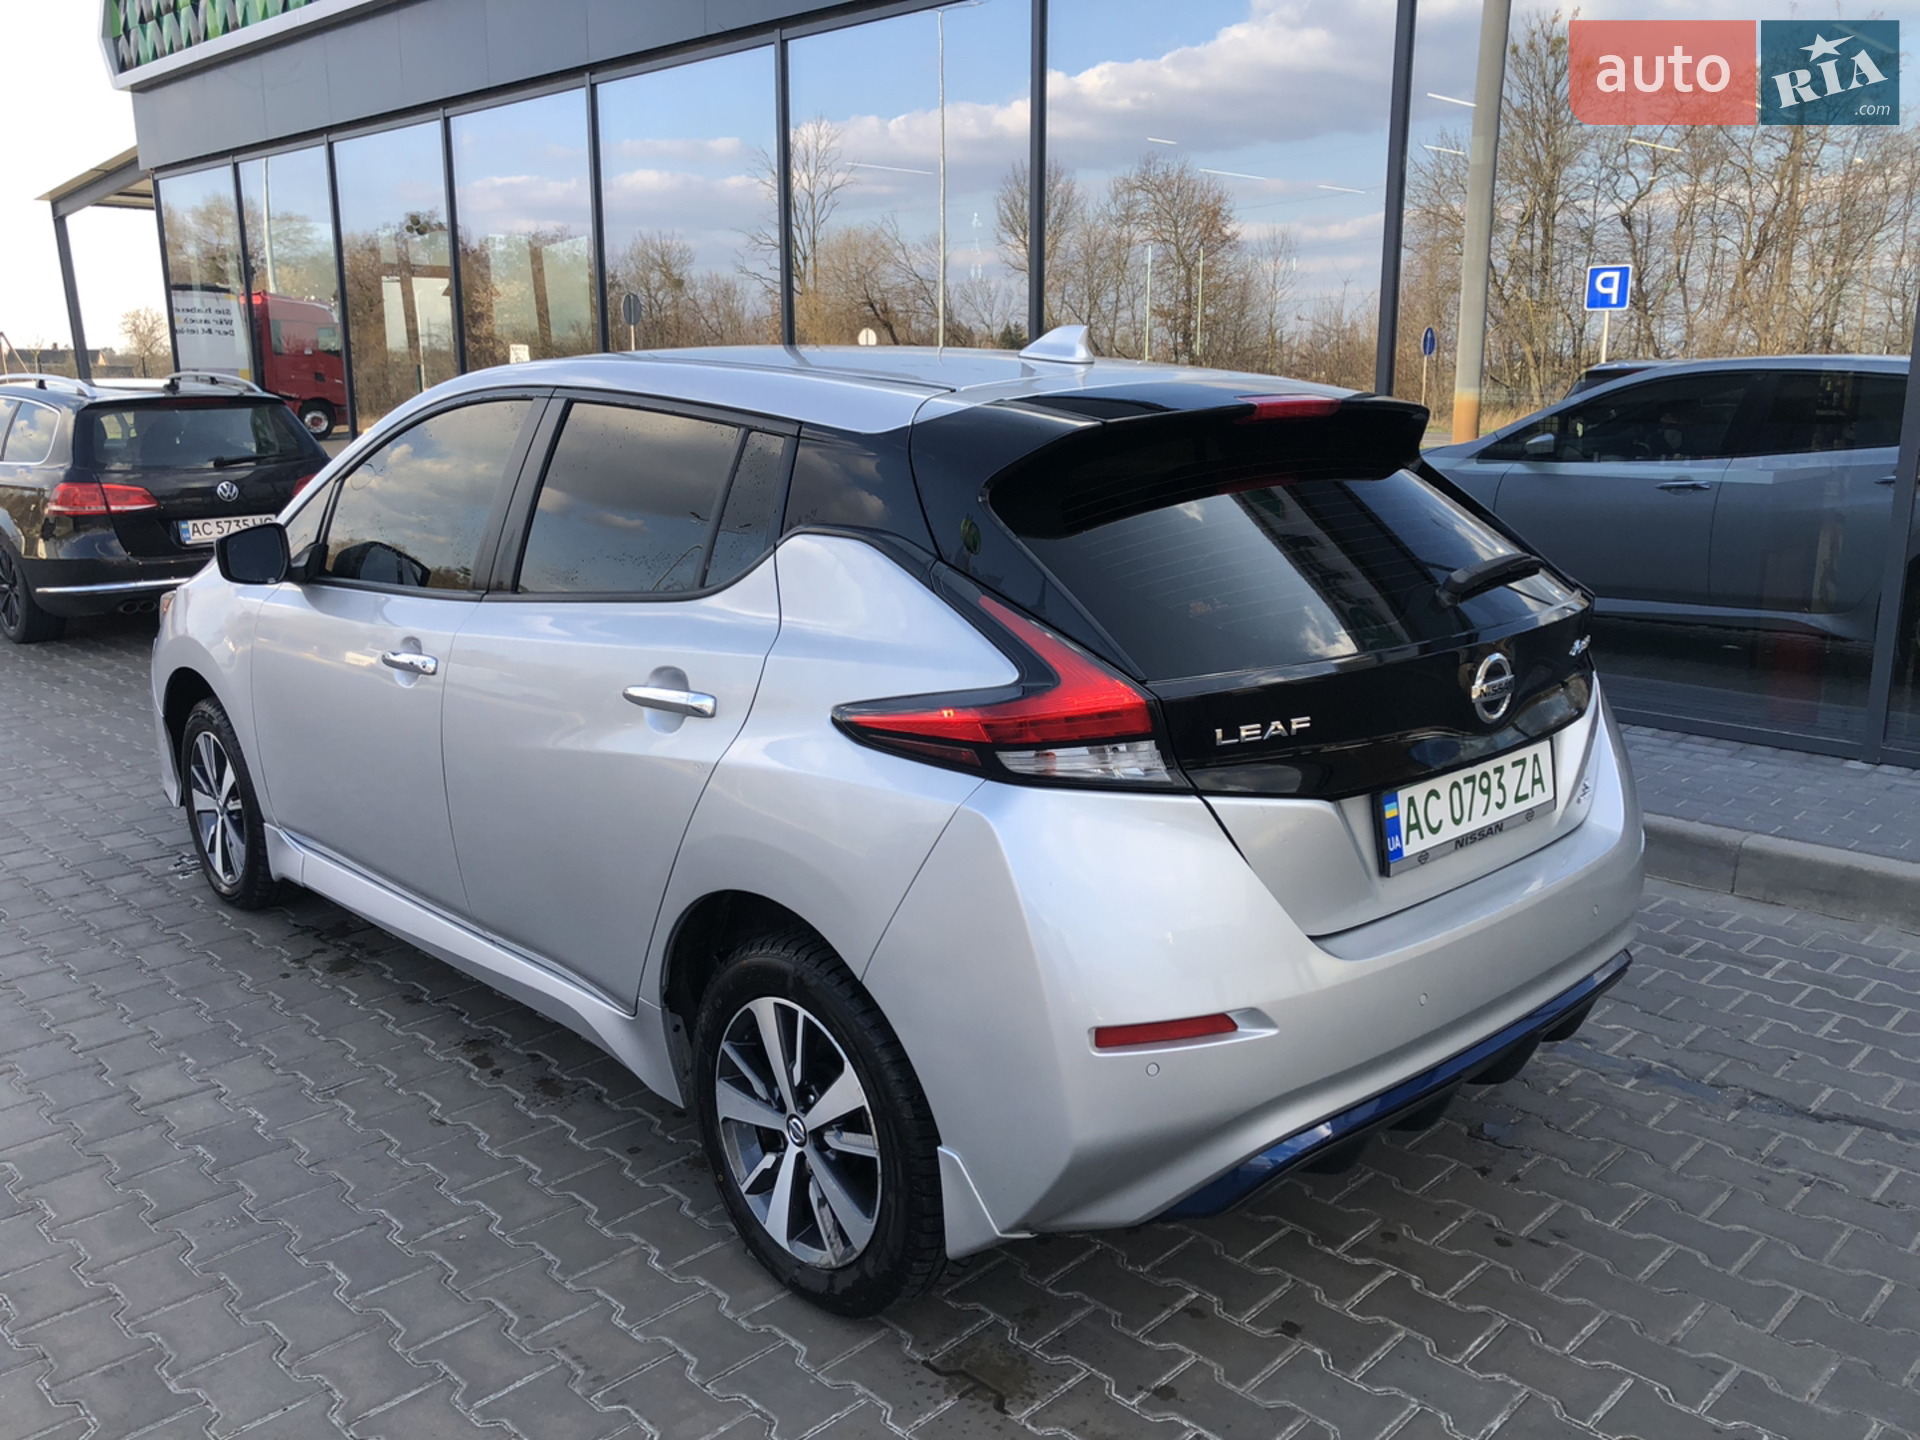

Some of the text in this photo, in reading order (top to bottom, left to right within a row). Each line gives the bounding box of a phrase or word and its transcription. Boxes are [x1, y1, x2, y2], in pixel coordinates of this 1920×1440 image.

[191, 522, 213, 537] AC
[1214, 716, 1311, 746] LEAF
[1405, 788, 1443, 845] AC
[1449, 765, 1507, 826] 0793
[1511, 753, 1546, 804] ZA
[1387, 834, 1402, 852] UA
[1454, 822, 1504, 850] NISSAN
